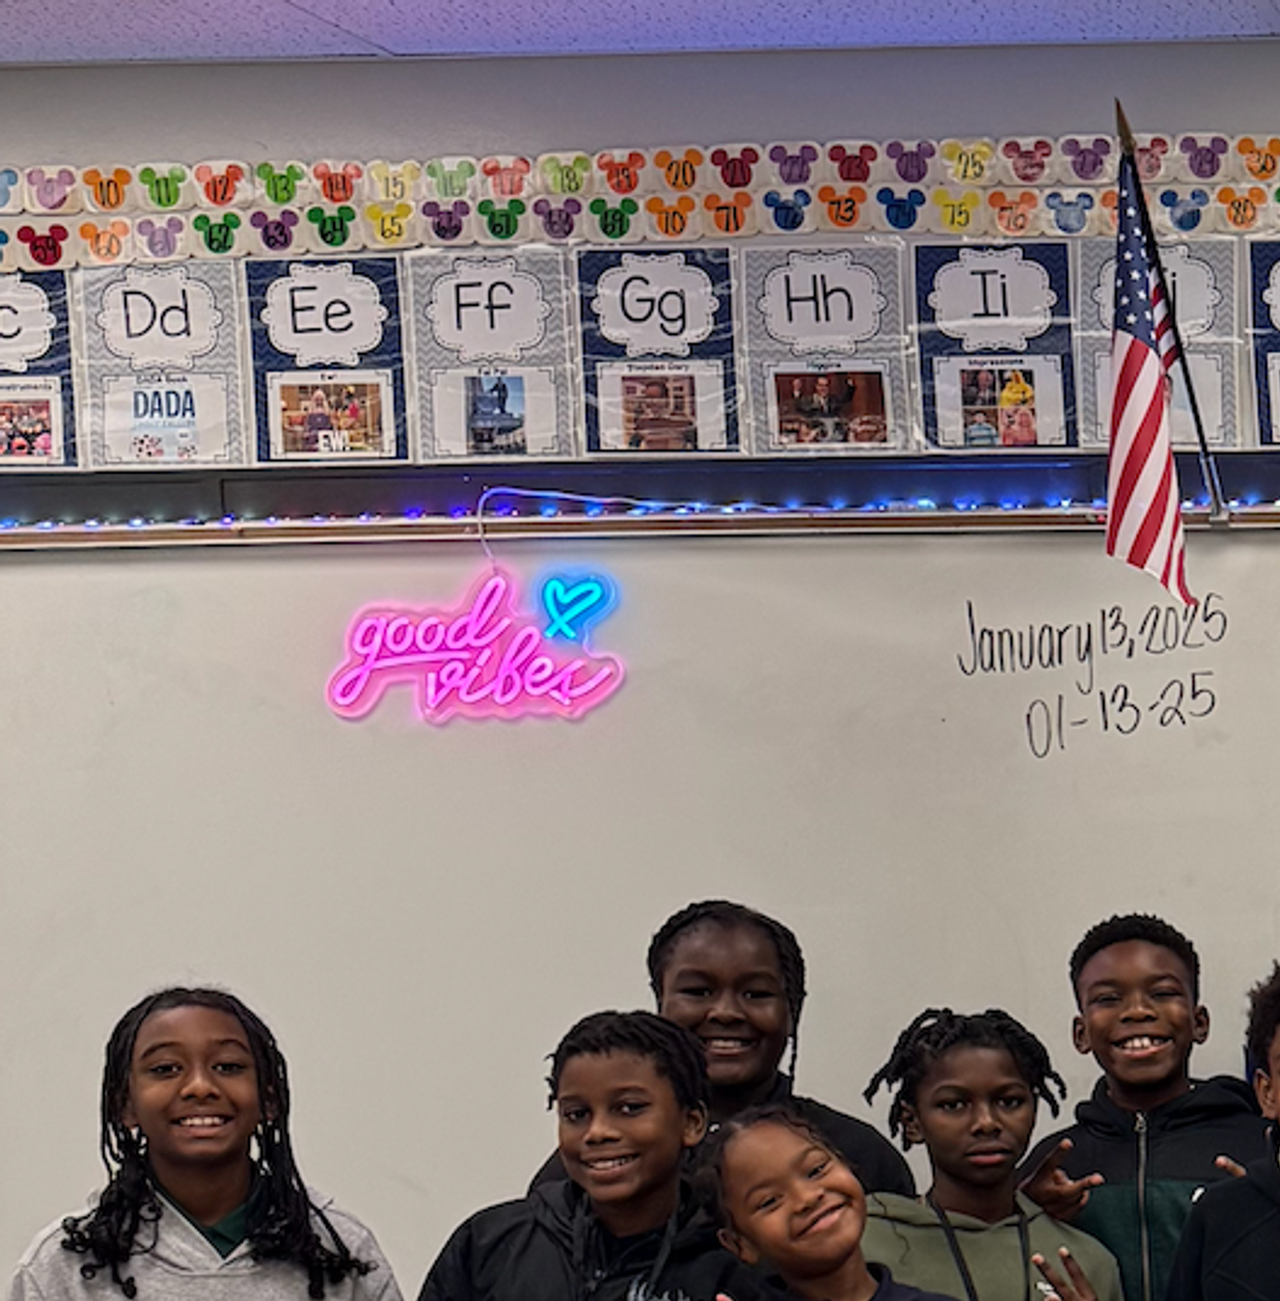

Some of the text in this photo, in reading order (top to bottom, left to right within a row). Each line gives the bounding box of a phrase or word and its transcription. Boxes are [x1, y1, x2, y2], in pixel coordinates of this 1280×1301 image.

[667, 160, 694, 189] 20
[958, 152, 984, 179] 25
[1248, 152, 1277, 177] 30
[156, 178, 173, 204] 11
[209, 175, 229, 202] 12
[268, 174, 290, 201] 13
[326, 174, 350, 199] 14
[385, 172, 404, 200] 15
[557, 166, 579, 193] 18
[99, 180, 119, 207] 10
[658, 208, 685, 233] 70
[715, 207, 739, 232] 71
[830, 199, 854, 222] 73
[944, 203, 970, 228] 75
[1230, 201, 1256, 226] 80
[207, 222, 233, 248] 62
[264, 221, 289, 246] 63
[320, 217, 346, 245] 64
[380, 217, 402, 242] 65
[30, 234, 58, 256] 59
[92, 234, 120, 256] 60
[454, 280, 515, 330] Ff
[619, 275, 687, 337] Gg
[784, 274, 854, 323] Hh
[970, 269, 1009, 319] Ii
[122, 290, 191, 339] Dd
[289, 286, 353, 335] Ee
[968, 358, 1025, 369] Impressions
[132, 390, 196, 419] DADA
[335, 575, 513, 706] good
[957, 599, 1094, 695] January
[426, 625, 612, 708] vibes
[1027, 670, 1217, 758] 01-13-25
